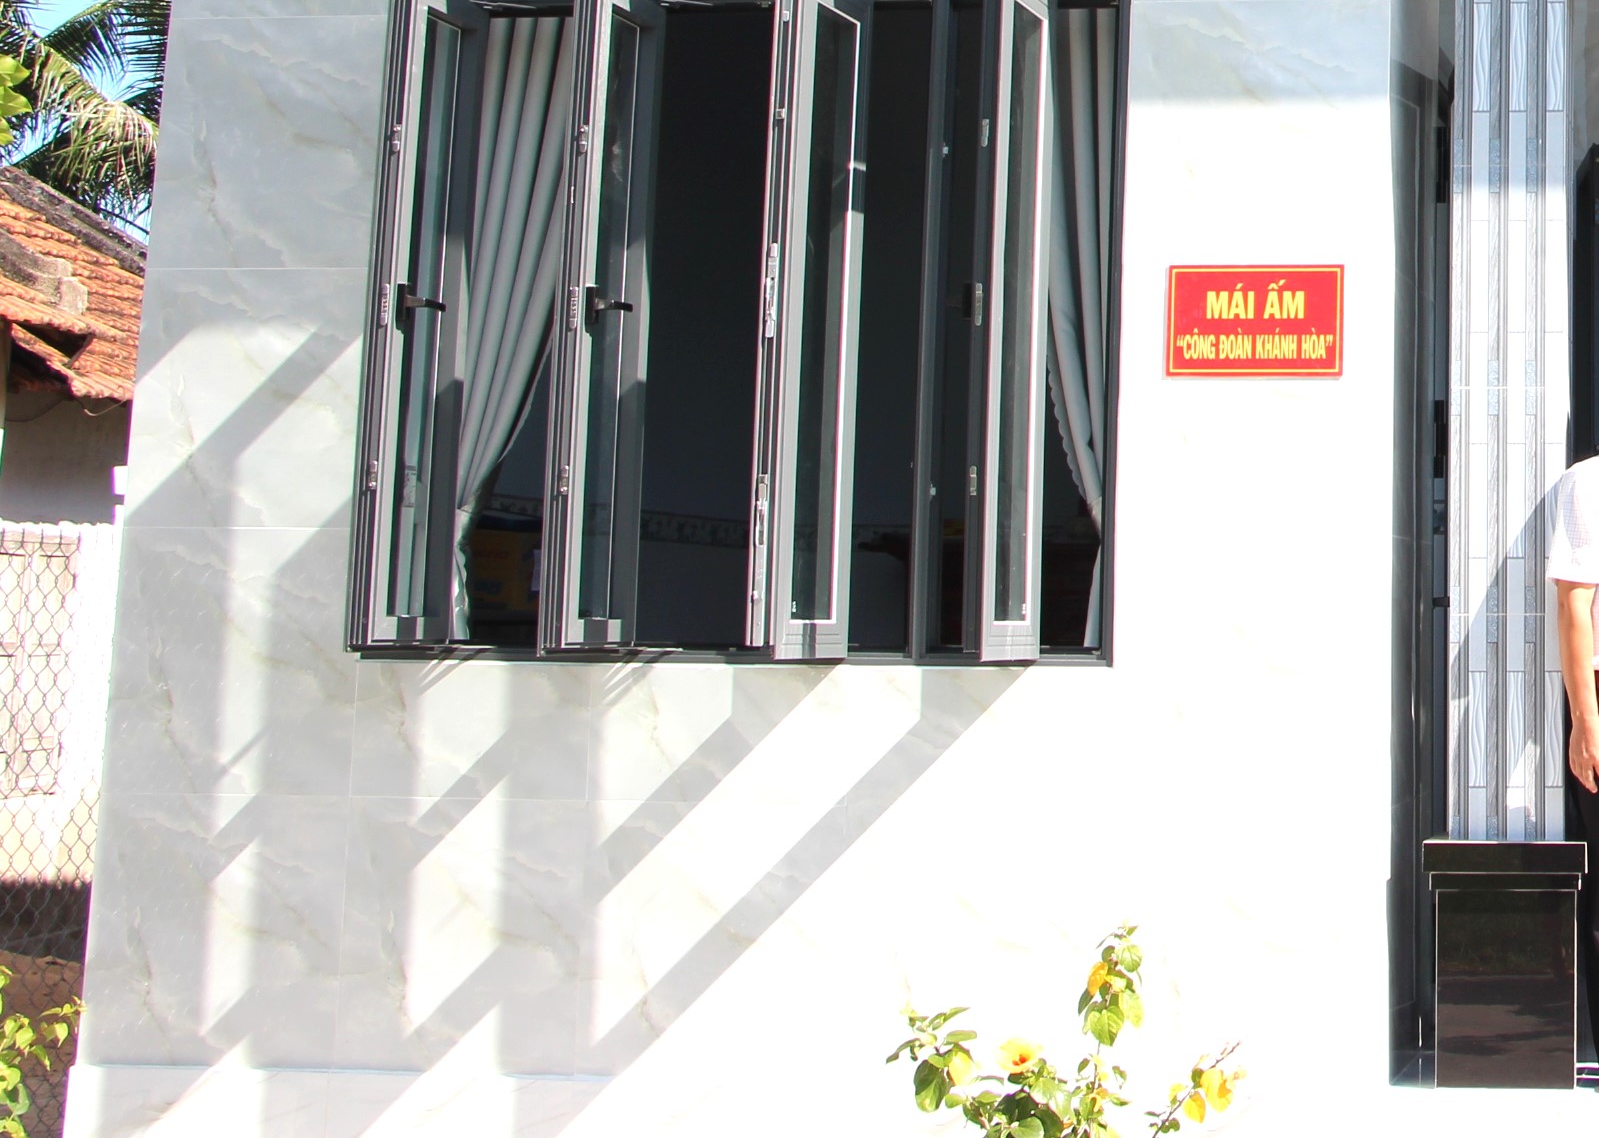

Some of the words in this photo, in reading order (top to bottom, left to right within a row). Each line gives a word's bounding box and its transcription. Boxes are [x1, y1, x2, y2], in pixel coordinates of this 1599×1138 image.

[1206, 283, 1255, 319] MÁI
[1263, 279, 1305, 319] ẤM
[1219, 327, 1252, 360] ĐOÀN
[1255, 327, 1297, 360] KHÁNH
